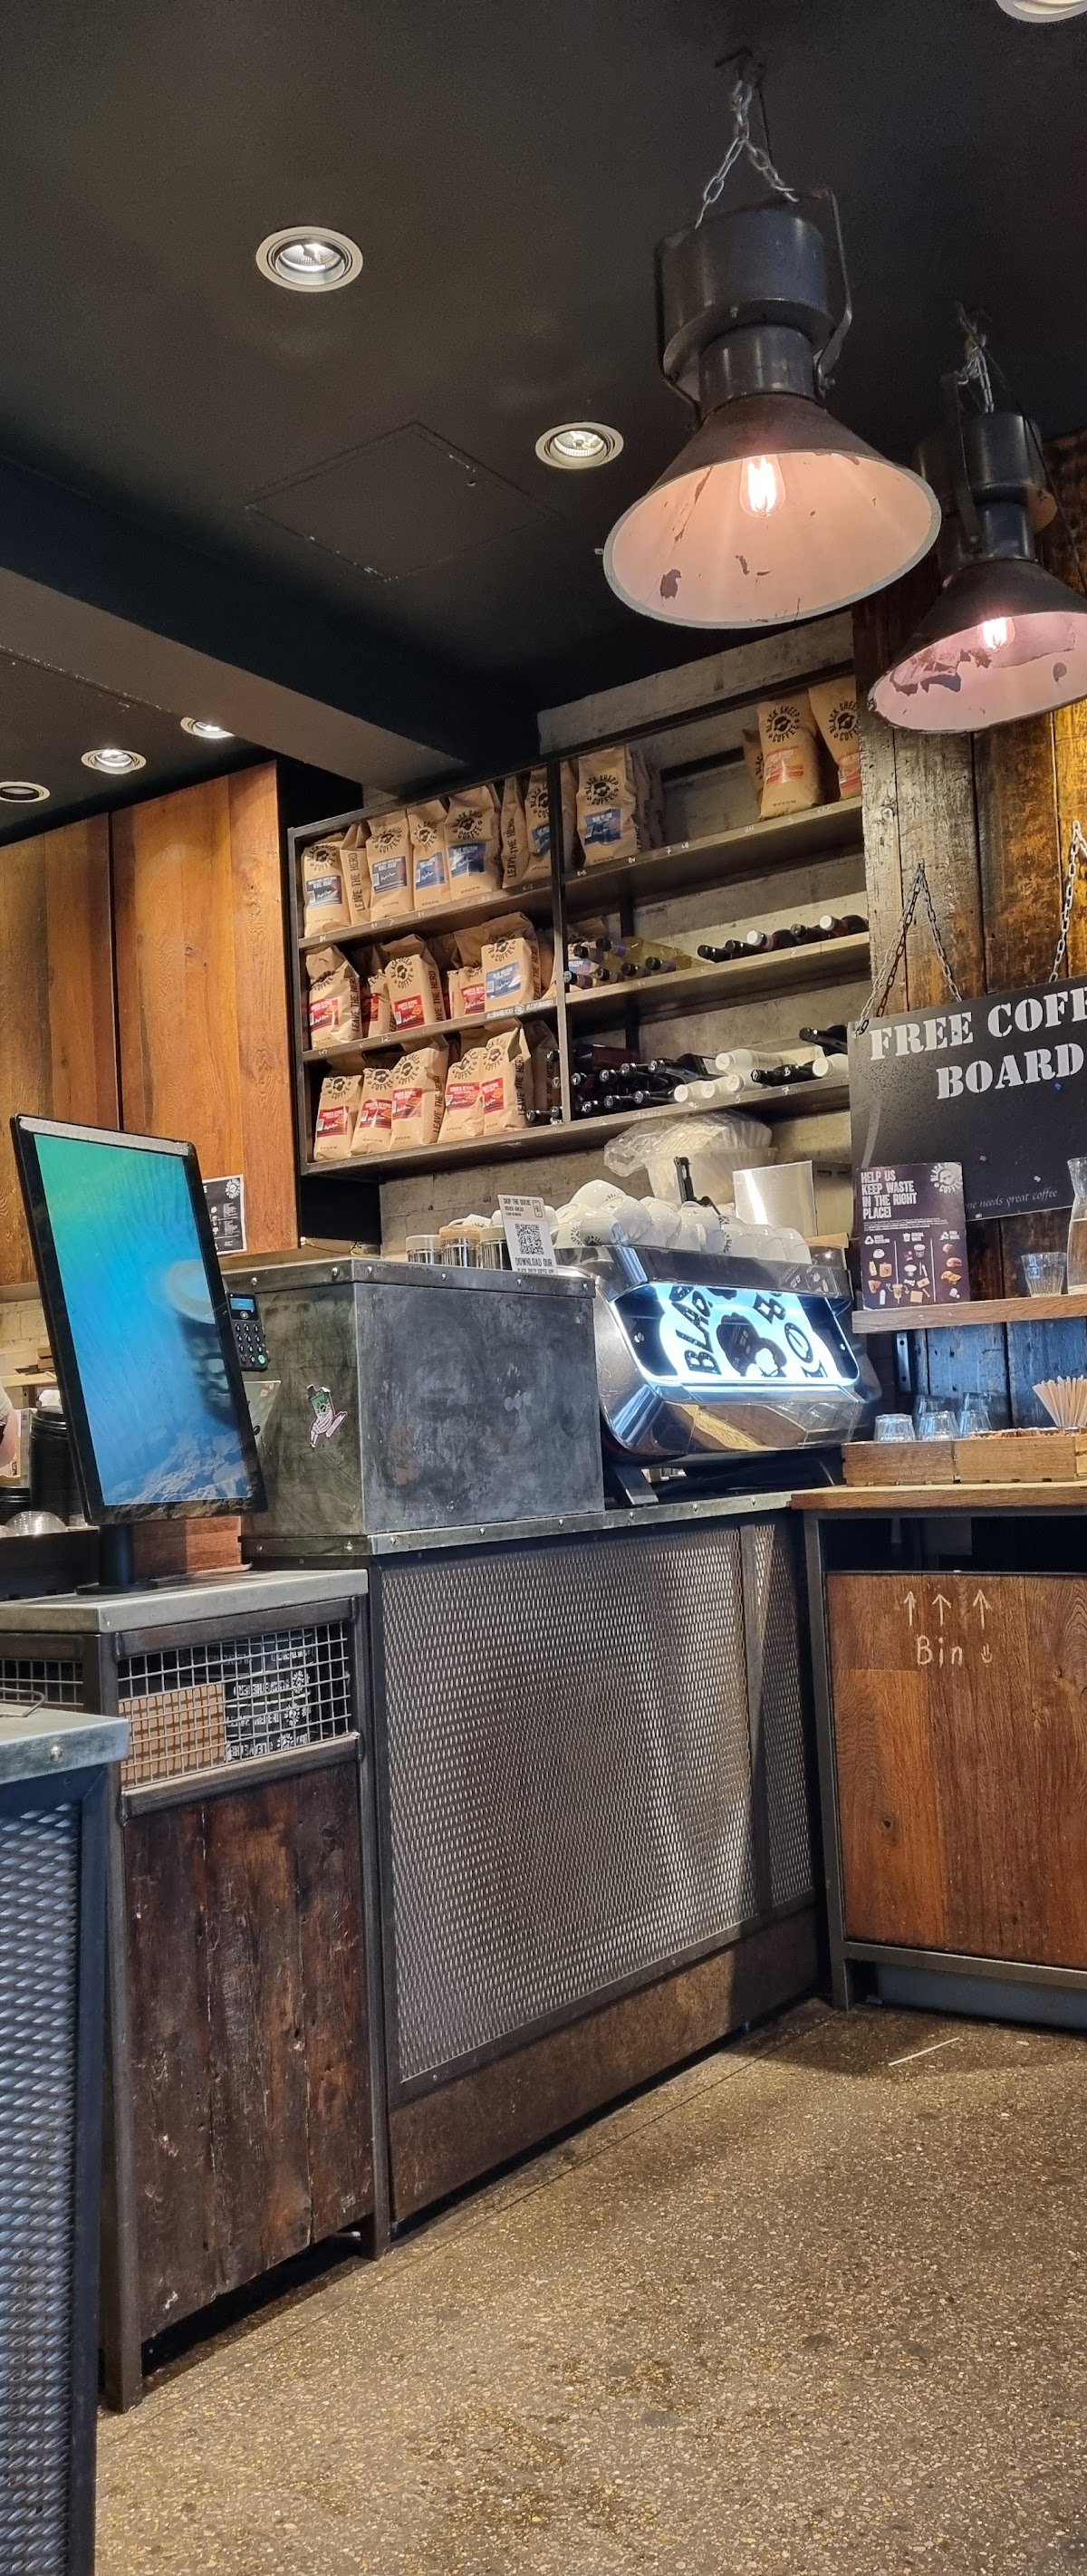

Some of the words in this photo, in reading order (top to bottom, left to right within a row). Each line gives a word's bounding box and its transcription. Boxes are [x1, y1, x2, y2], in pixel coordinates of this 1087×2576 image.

[765, 709, 779, 734] BLACK
[780, 706, 800, 718] SHEEP
[772, 725, 799, 743] COFFEE
[458, 825, 482, 841] COFFEE
[508, 839, 517, 854] THE
[348, 852, 360, 870] HERD
[507, 856, 517, 879] LEAVE
[351, 873, 361, 887] THE
[352, 889, 365, 911] LEAVE
[495, 945, 515, 962] COFFEE
[399, 973, 413, 988] COFFEE
[429, 971, 438, 988] HERD
[351, 995, 360, 1007] THE
[432, 991, 441, 1004] THE
[351, 1009, 360, 1032] LEAVE
[870, 1012, 974, 1061] FREE
[454, 1063, 475, 1080] COFFEE
[936, 1043, 1085, 1100] BOARD
[371, 1080, 393, 1091] COFFEE
[515, 1075, 524, 1088] THE
[435, 1093, 443, 1107] THE
[517, 1092, 525, 1116] LEAVE
[433, 1108, 441, 1133] LEAVE
[861, 1171, 881, 1184] HELP
[884, 1170, 896, 1182] US
[862, 1182, 883, 1196] KEEP
[886, 1180, 915, 1194] WASTE
[862, 1196, 873, 1207] IN
[874, 1194, 890, 1206] THE
[893, 1192, 918, 1205] RIGHT
[979, 1195, 1003, 1208] needs
[1006, 1193, 1029, 1207] great
[1032, 1187, 1058, 1202] coffee
[862, 1206, 892, 1220] PLACE!
[515, 1257, 542, 1266] DOWNLOAD
[544, 1258, 553, 1267] OUR
[917, 1634, 963, 1668] Bin
